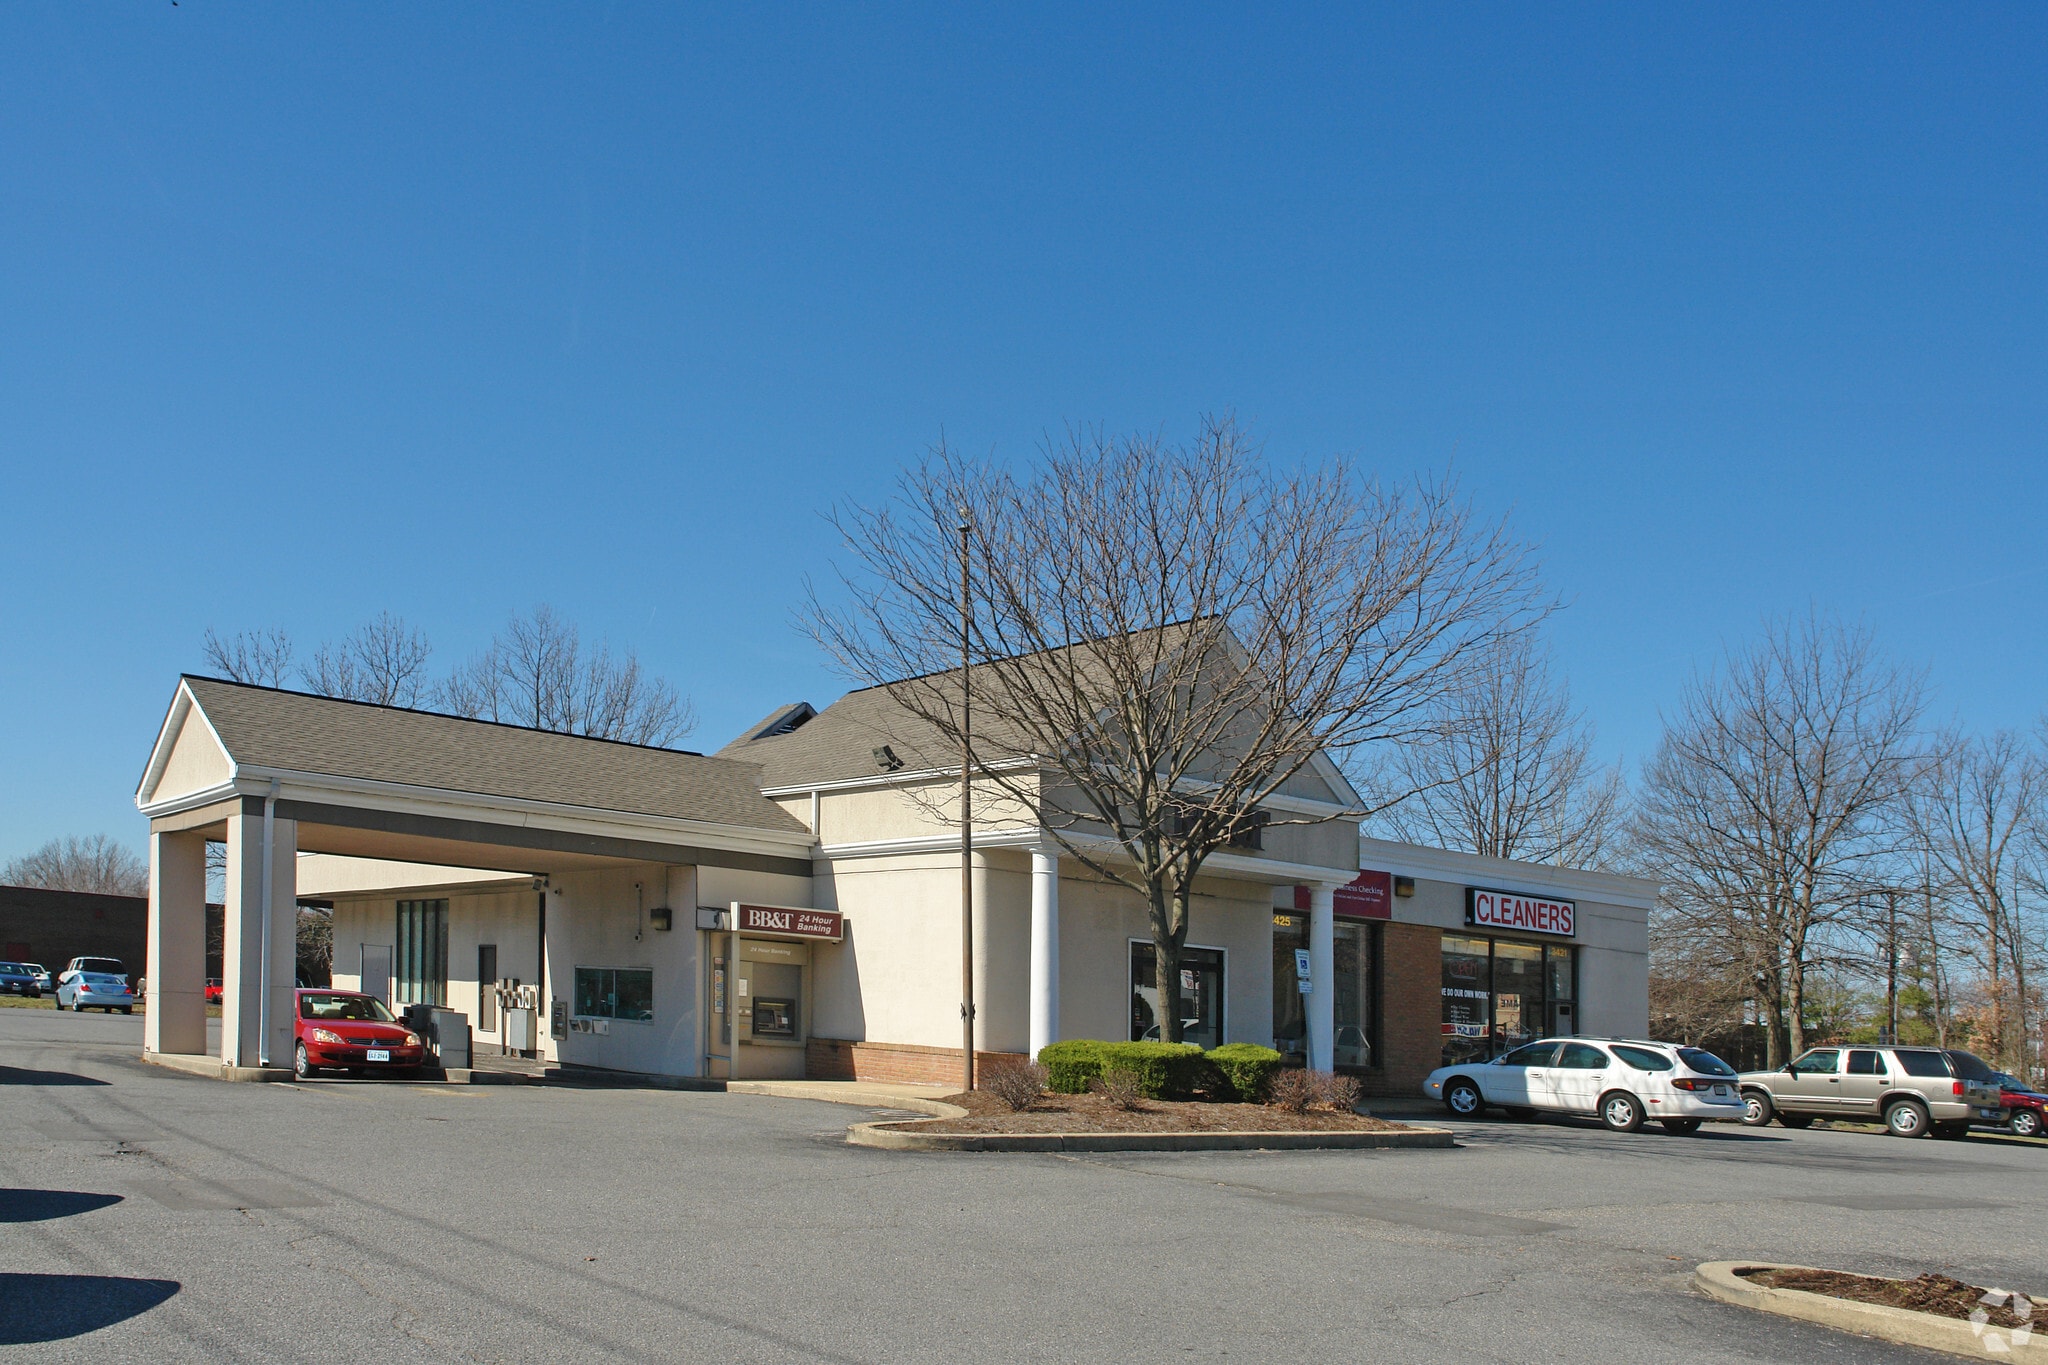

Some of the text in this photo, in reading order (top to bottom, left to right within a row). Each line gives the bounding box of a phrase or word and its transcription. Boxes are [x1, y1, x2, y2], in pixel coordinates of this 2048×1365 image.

[1359, 885, 1384, 896] Checking
[748, 909, 794, 929] BB&T
[1476, 894, 1572, 933] CLEANERS
[799, 914, 833, 925] 24 Hour
[1272, 915, 1291, 926] 425
[797, 923, 832, 934] Banking
[771, 948, 791, 956] Banking
[1447, 988, 1454, 996] DO
[1454, 989, 1464, 998] OUR
[1464, 990, 1474, 998] OWN
